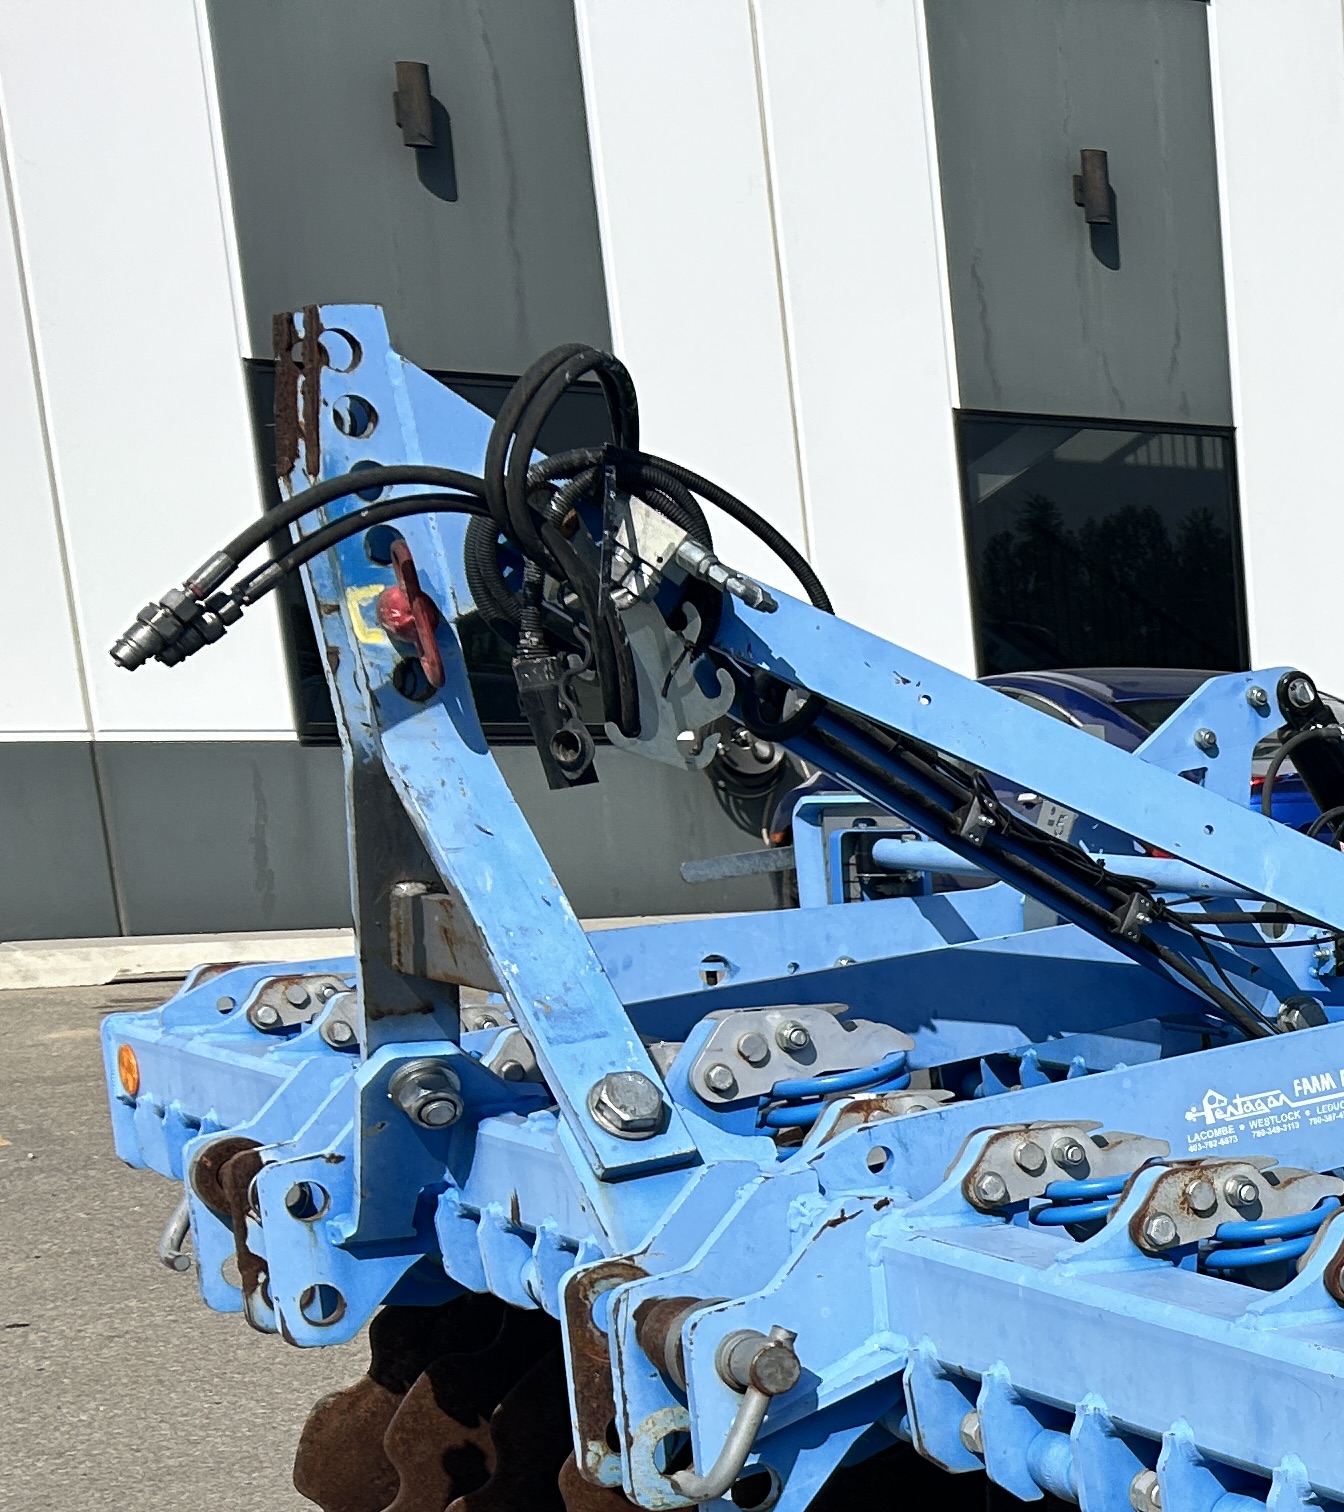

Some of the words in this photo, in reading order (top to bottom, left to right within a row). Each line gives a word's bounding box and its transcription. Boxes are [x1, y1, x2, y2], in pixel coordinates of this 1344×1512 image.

[1293, 1072, 1337, 1097] FARM
[1203, 1089, 1293, 1125] Pentagon
[1187, 1125, 1235, 1143] LACOMBE
[1249, 1110, 1301, 1129] WESTLOCK
